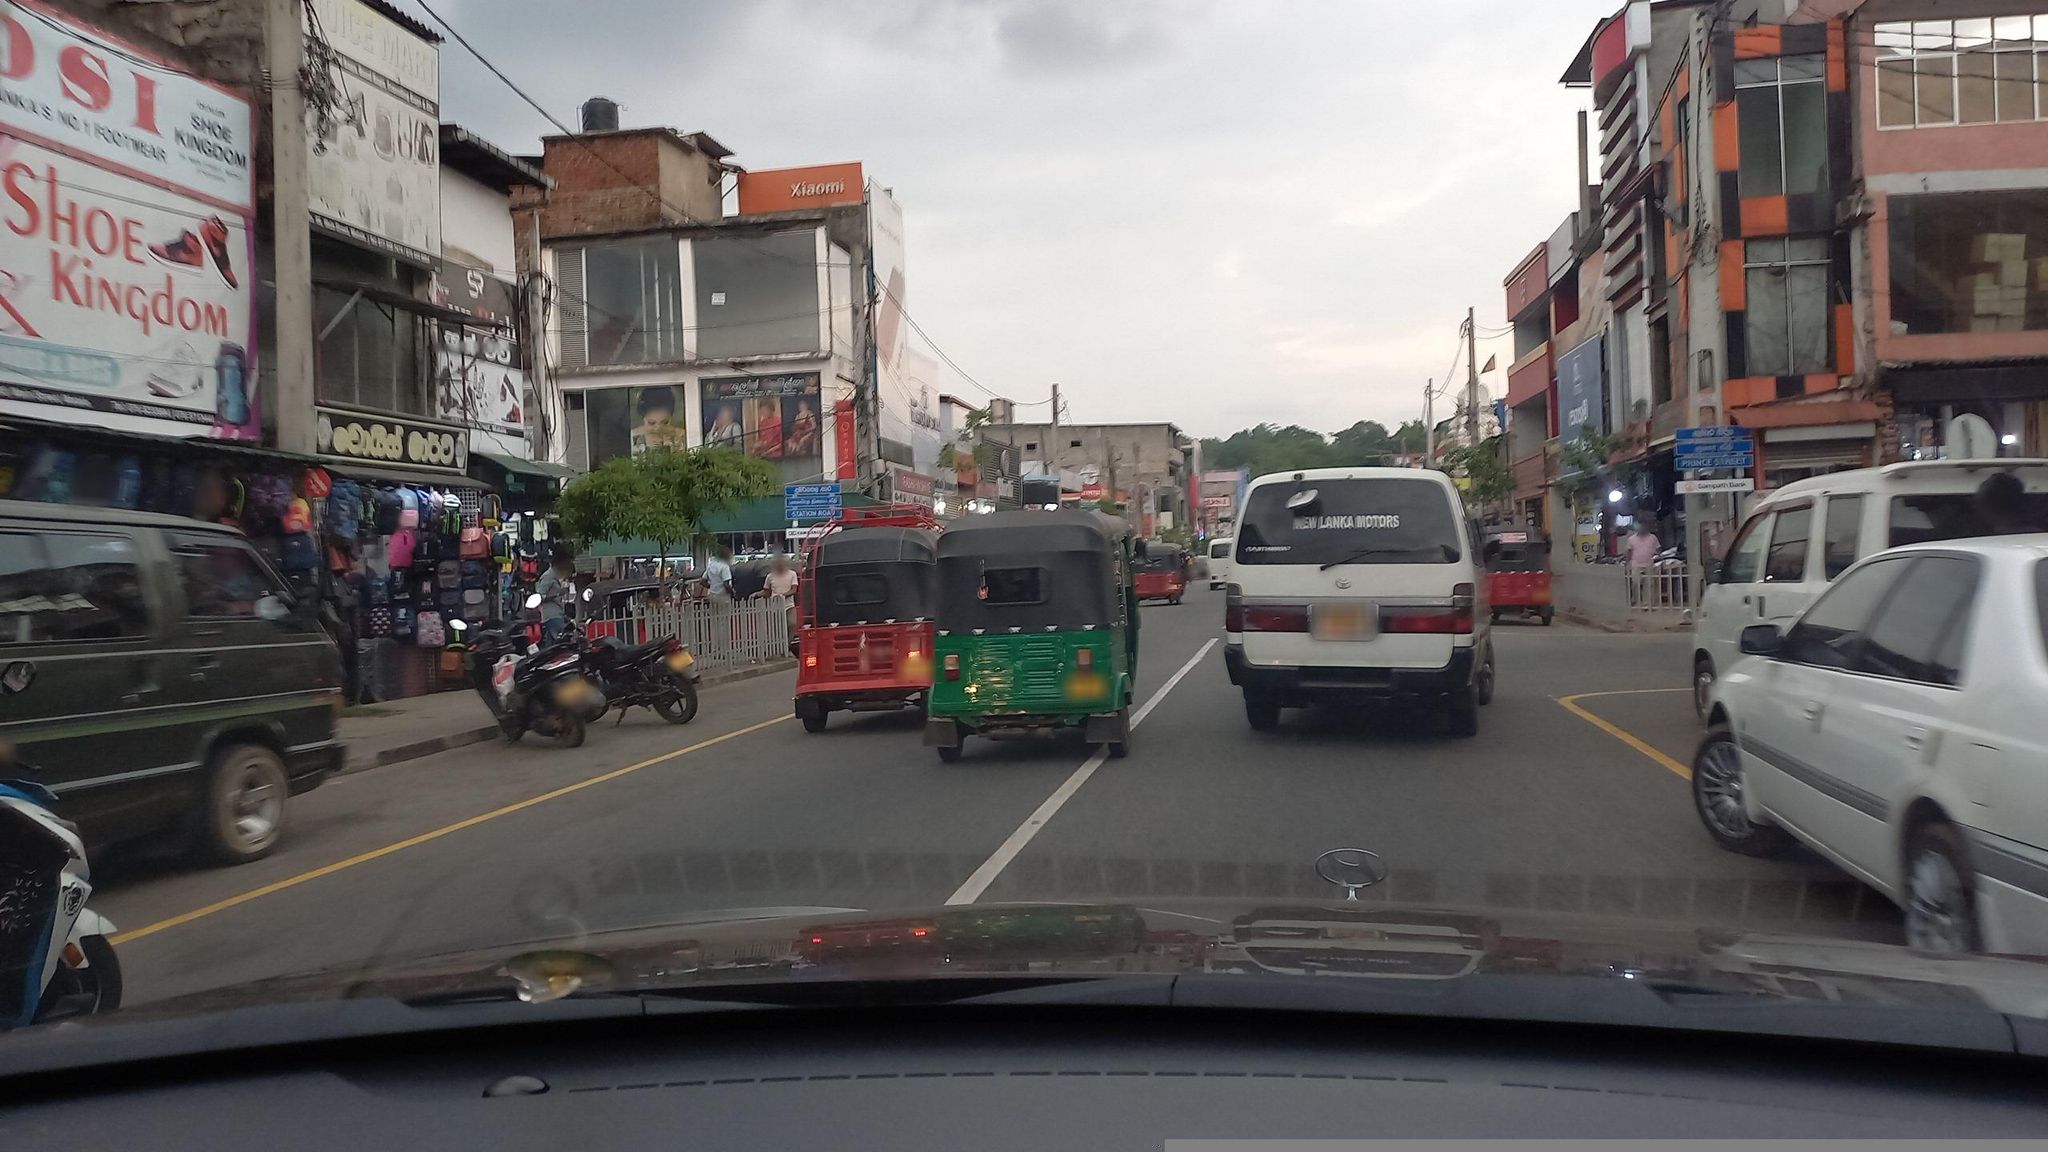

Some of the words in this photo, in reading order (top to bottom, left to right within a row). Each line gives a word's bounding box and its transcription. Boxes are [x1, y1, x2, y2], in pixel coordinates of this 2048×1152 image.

[191, 112, 232, 145] SHOE
[94, 122, 168, 164] FOOTWEAR
[174, 127, 247, 170] KINGDOM
[791, 178, 844, 198] Xiaomi
[1681, 458, 1713, 467] PRINCE
[1714, 456, 1746, 466] STREET
[1697, 481, 1729, 490] Sampath
[791, 510, 817, 518] STATION
[1293, 516, 1317, 529] NEW
[1318, 516, 1354, 529] LANKA
[1355, 515, 1399, 529] MOTORS
